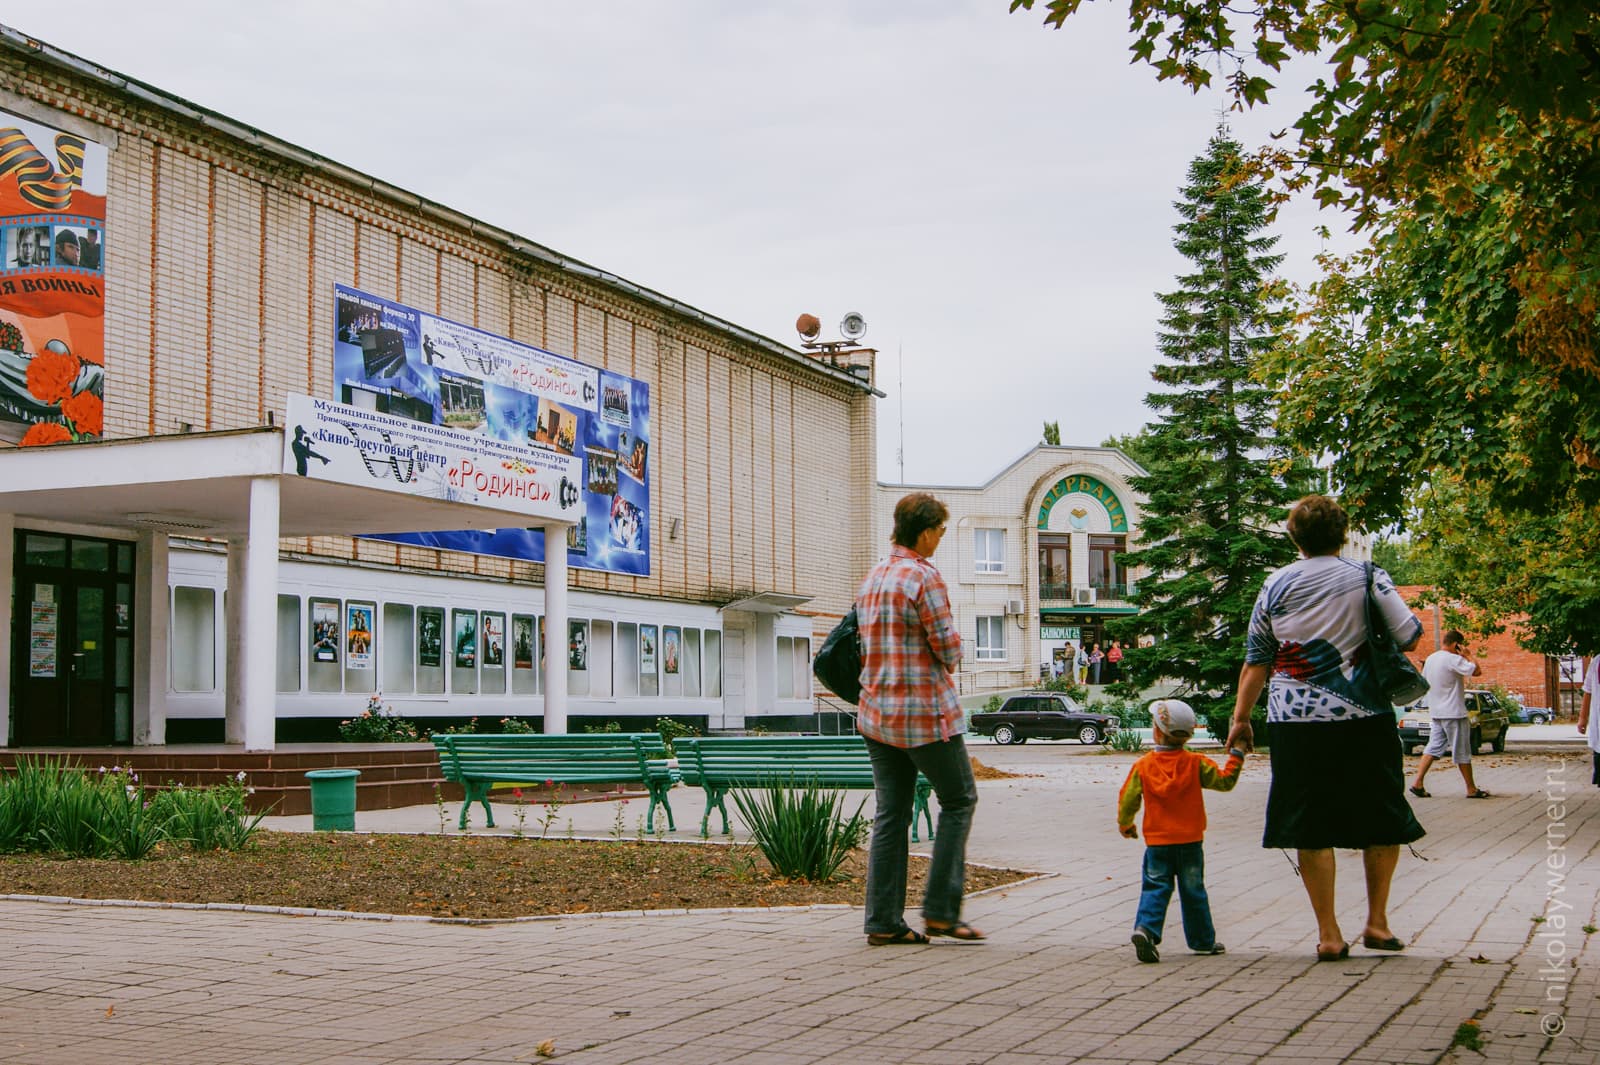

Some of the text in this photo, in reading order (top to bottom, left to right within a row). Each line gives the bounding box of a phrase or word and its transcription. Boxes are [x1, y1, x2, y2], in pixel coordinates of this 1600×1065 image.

[21, 275, 101, 298] ВОЙНЫ
[512, 364, 577, 397] «Родина»
[313, 400, 408, 428] Муниципальное
[411, 424, 471, 442] автономное
[474, 437, 529, 455] учреждение
[531, 450, 570, 464] культуры
[317, 412, 404, 438] Приморско-Ахтарского
[405, 433, 444, 446] городского
[444, 442, 478, 454] поселения
[547, 463, 567, 473] района
[417, 450, 447, 468] центр
[448, 458, 551, 502] «Родина»
[1037, 476, 1124, 528] СБЕРБАНК
